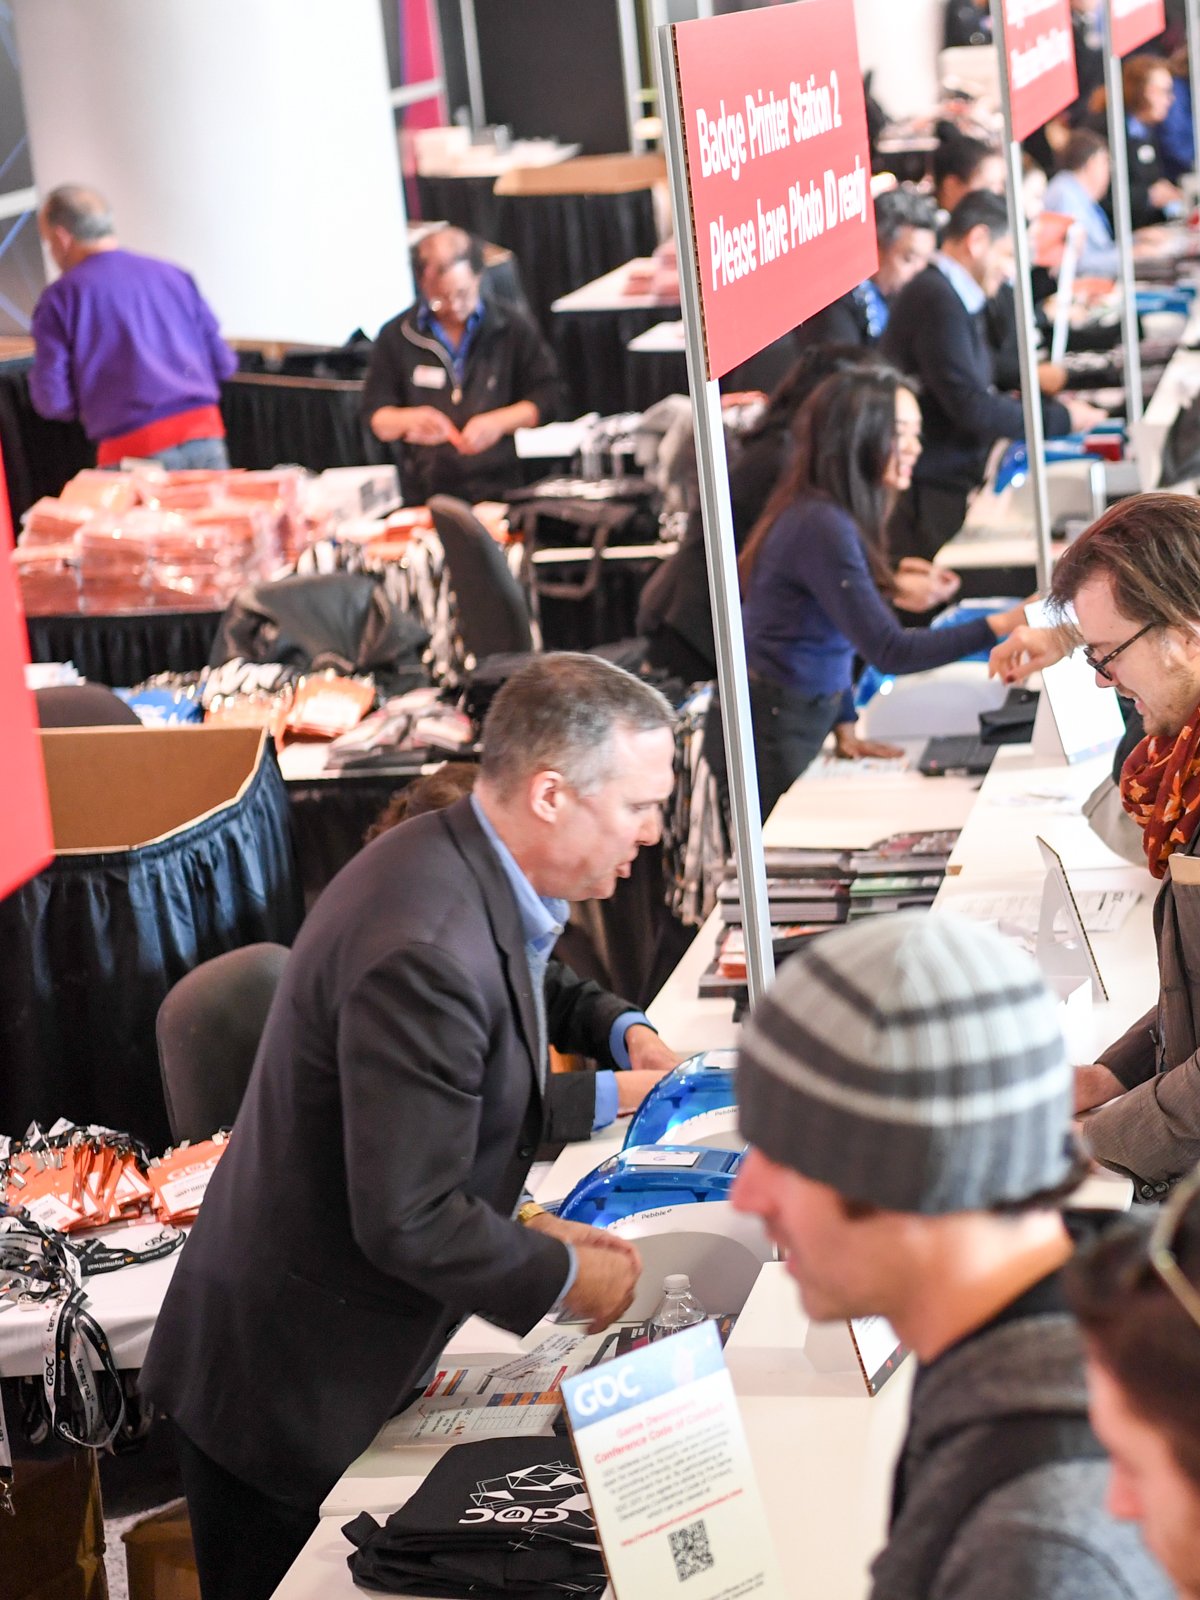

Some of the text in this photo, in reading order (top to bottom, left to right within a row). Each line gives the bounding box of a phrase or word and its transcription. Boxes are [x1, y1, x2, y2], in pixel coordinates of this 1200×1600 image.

[696, 69, 842, 181] Badge Printer Station 2
[709, 154, 867, 292] Please have Photo ID ready
[641, 1210, 666, 1219] Pebble
[46, 1357, 55, 1387] GDC
[573, 1363, 642, 1417] GDC
[593, 1435, 648, 1465] Conference
[648, 1424, 674, 1442] Code
[458, 1506, 570, 1524] GDC
